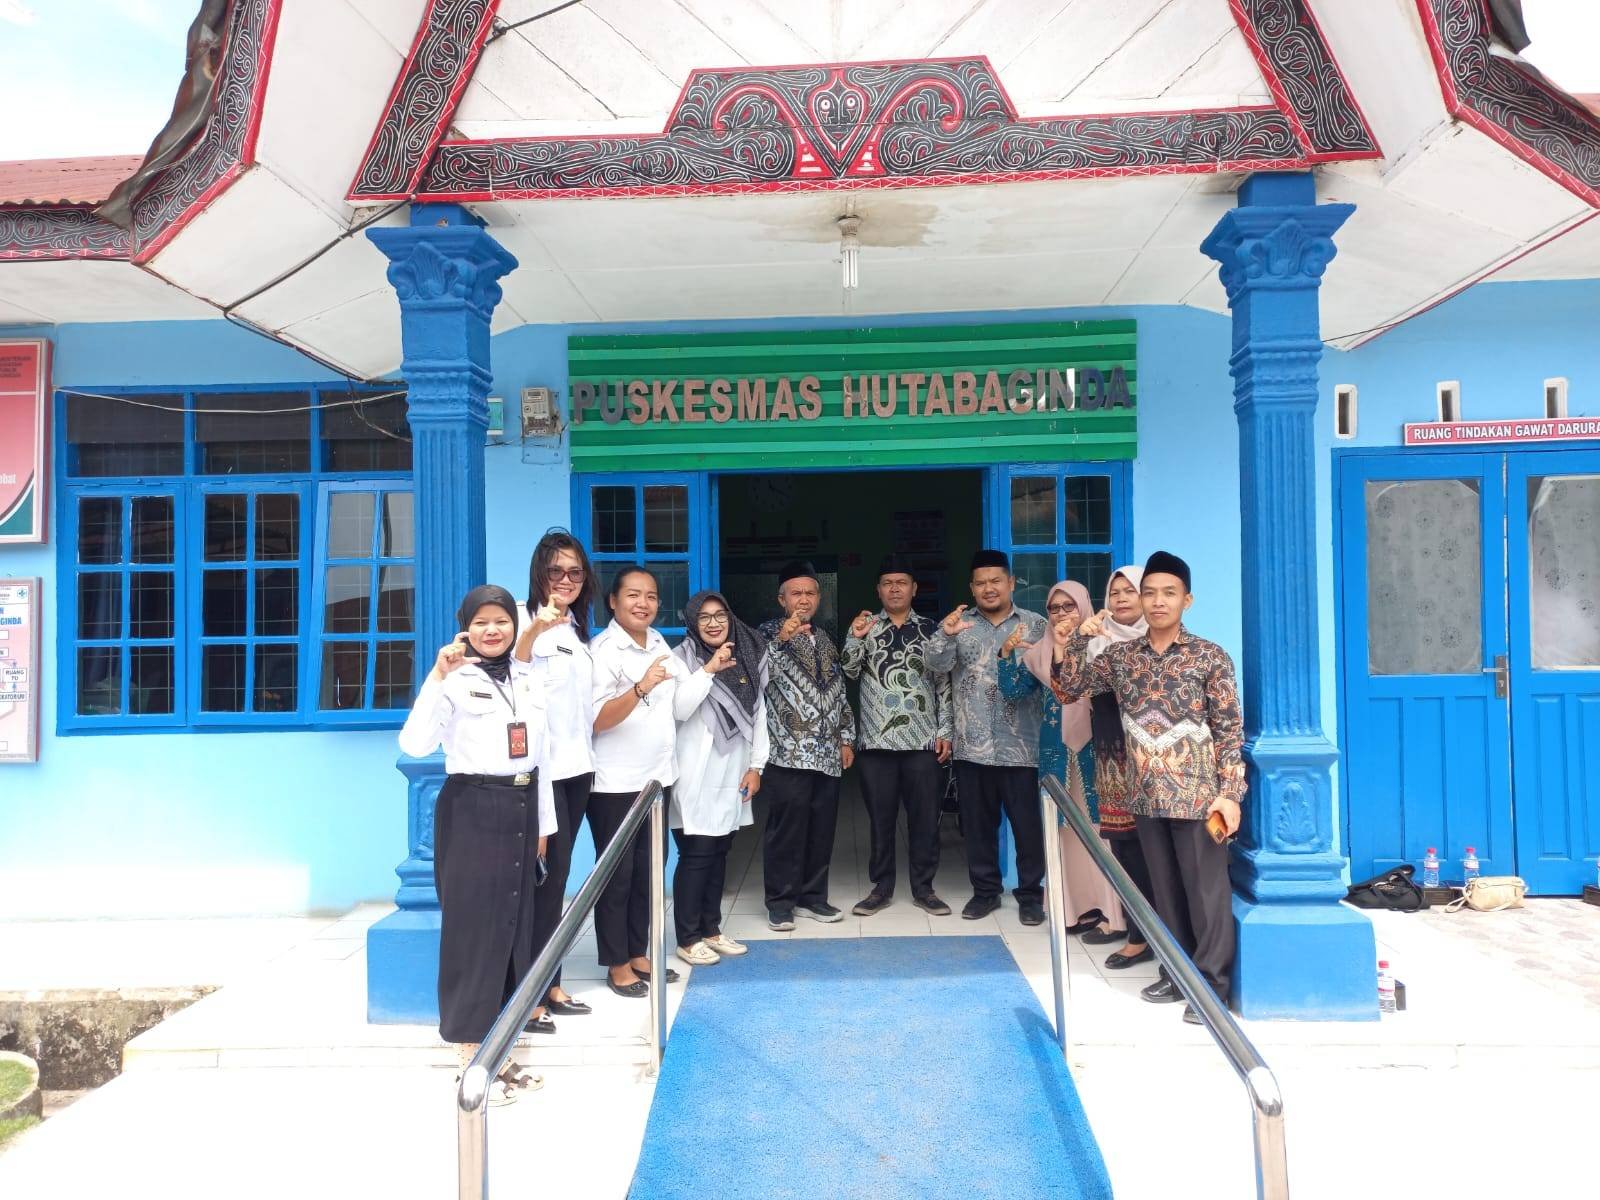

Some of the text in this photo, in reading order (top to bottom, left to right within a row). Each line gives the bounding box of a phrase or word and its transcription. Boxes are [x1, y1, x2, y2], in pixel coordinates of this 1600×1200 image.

[573, 375, 822, 425] PUSKESMAS
[843, 366, 1131, 420] HUTABAGINDA
[1414, 427, 1452, 440] RUANG
[1455, 425, 1512, 438] TINDAKAN
[1515, 423, 1554, 437] GAWAT
